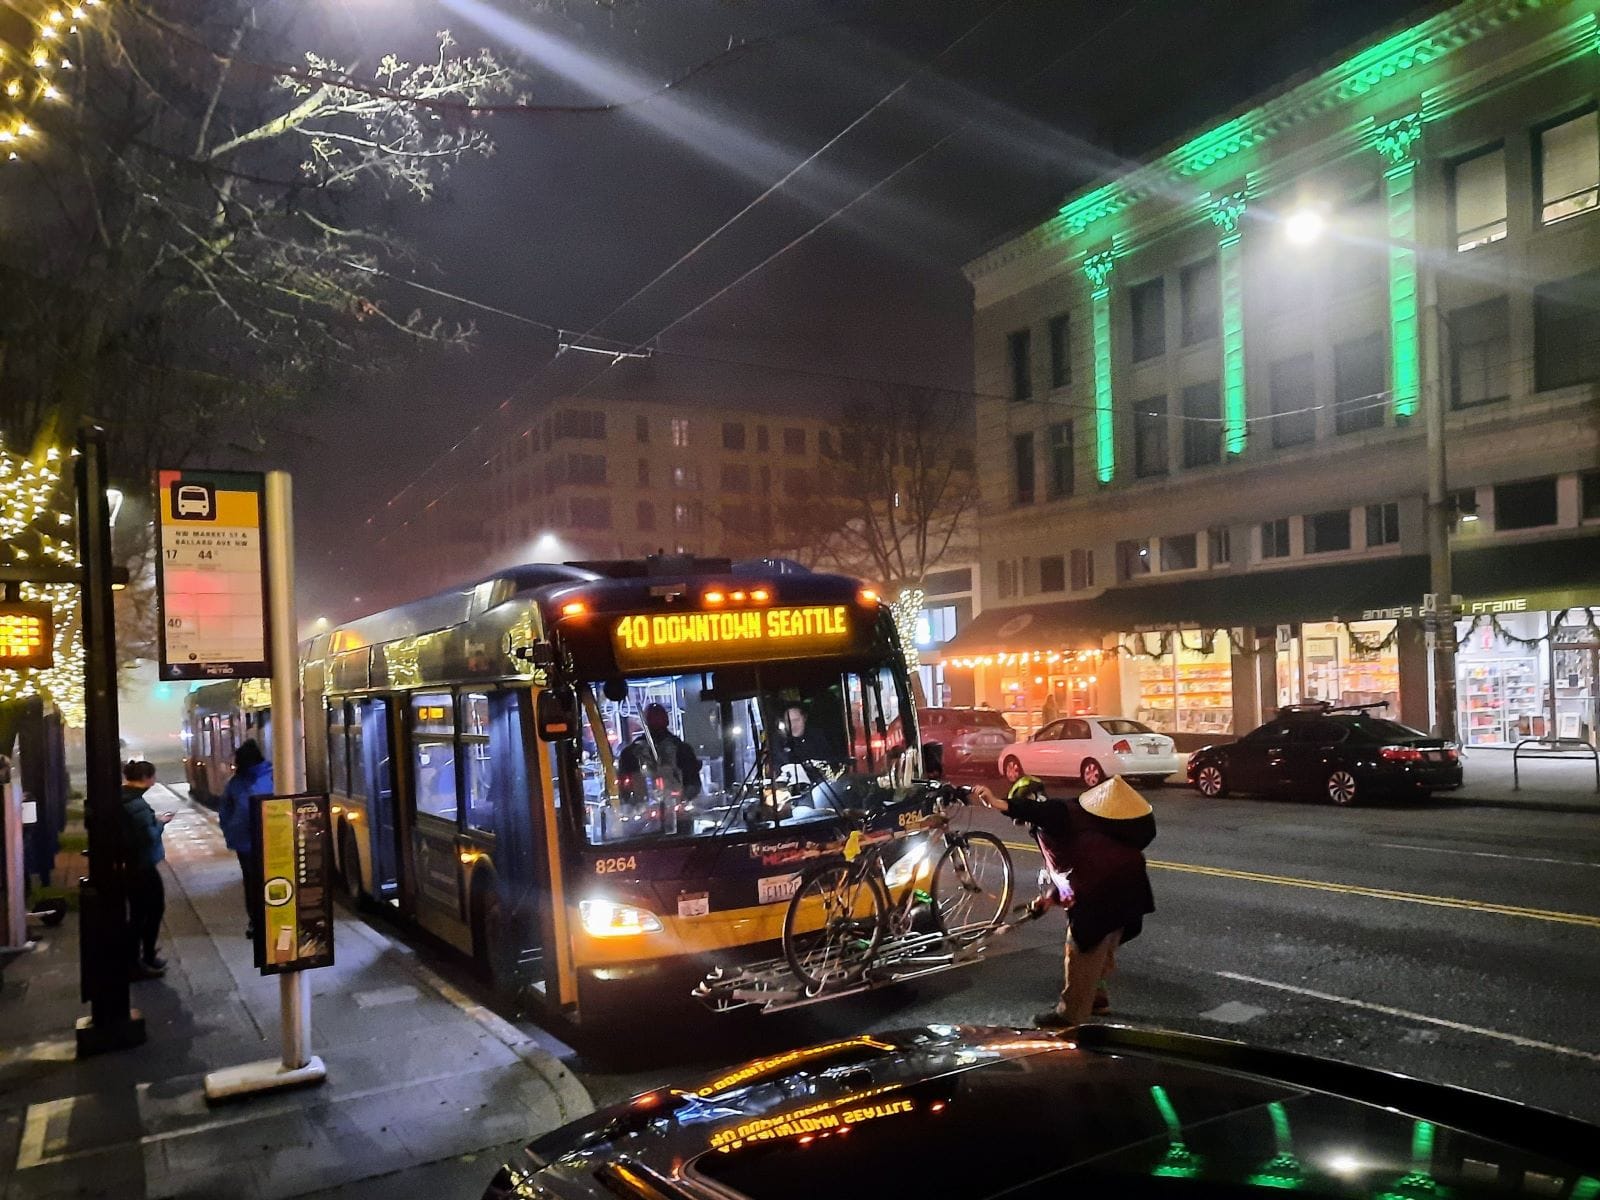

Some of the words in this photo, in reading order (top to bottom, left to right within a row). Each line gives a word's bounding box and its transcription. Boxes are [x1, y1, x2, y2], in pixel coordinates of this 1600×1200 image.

[166, 549, 178, 559] 17
[198, 550, 213, 560] 44
[167, 618, 182, 628] 40
[616, 614, 650, 649] 40
[653, 611, 762, 645] DOWNTOWN
[767, 606, 847, 638] SEATTLE
[898, 809, 923, 827] 8264
[595, 855, 637, 874] 8264
